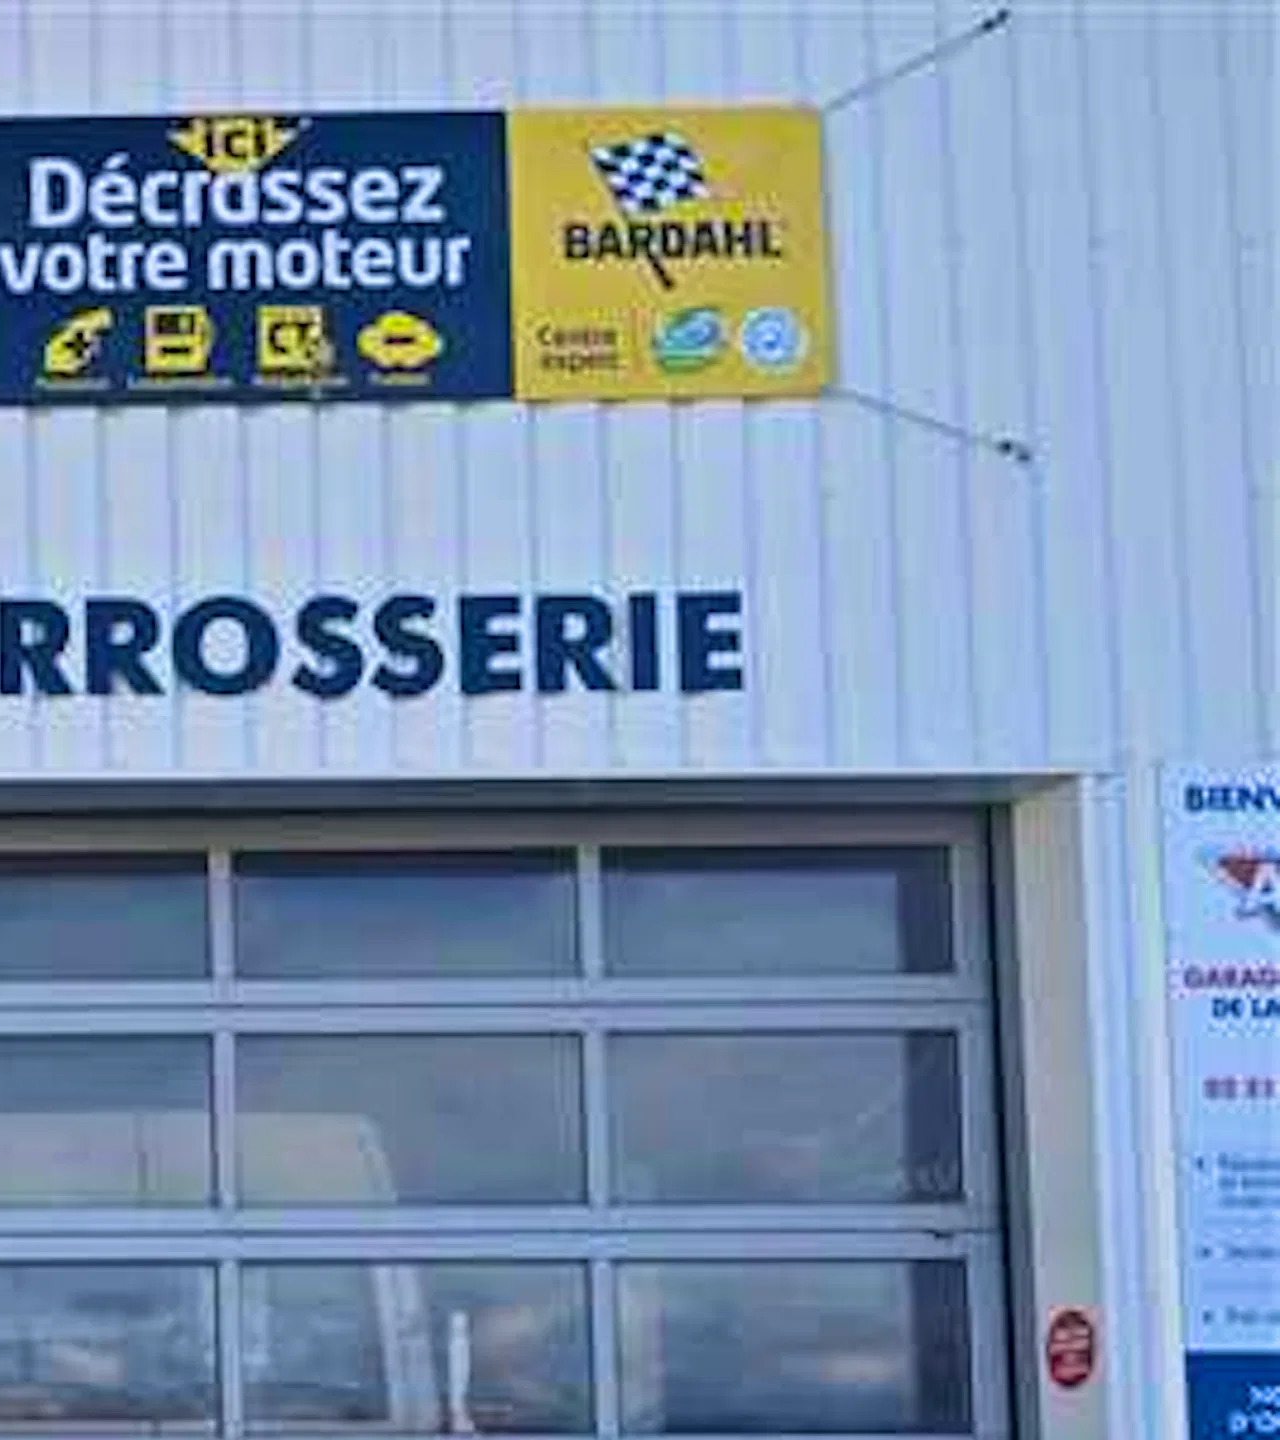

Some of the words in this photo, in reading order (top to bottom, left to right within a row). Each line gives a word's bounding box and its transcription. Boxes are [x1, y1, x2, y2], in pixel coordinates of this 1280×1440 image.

[28, 152, 445, 228] Décrassez
[0, 231, 189, 294] votre
[207, 228, 472, 293] moteur
[564, 220, 782, 262] BARDAHL
